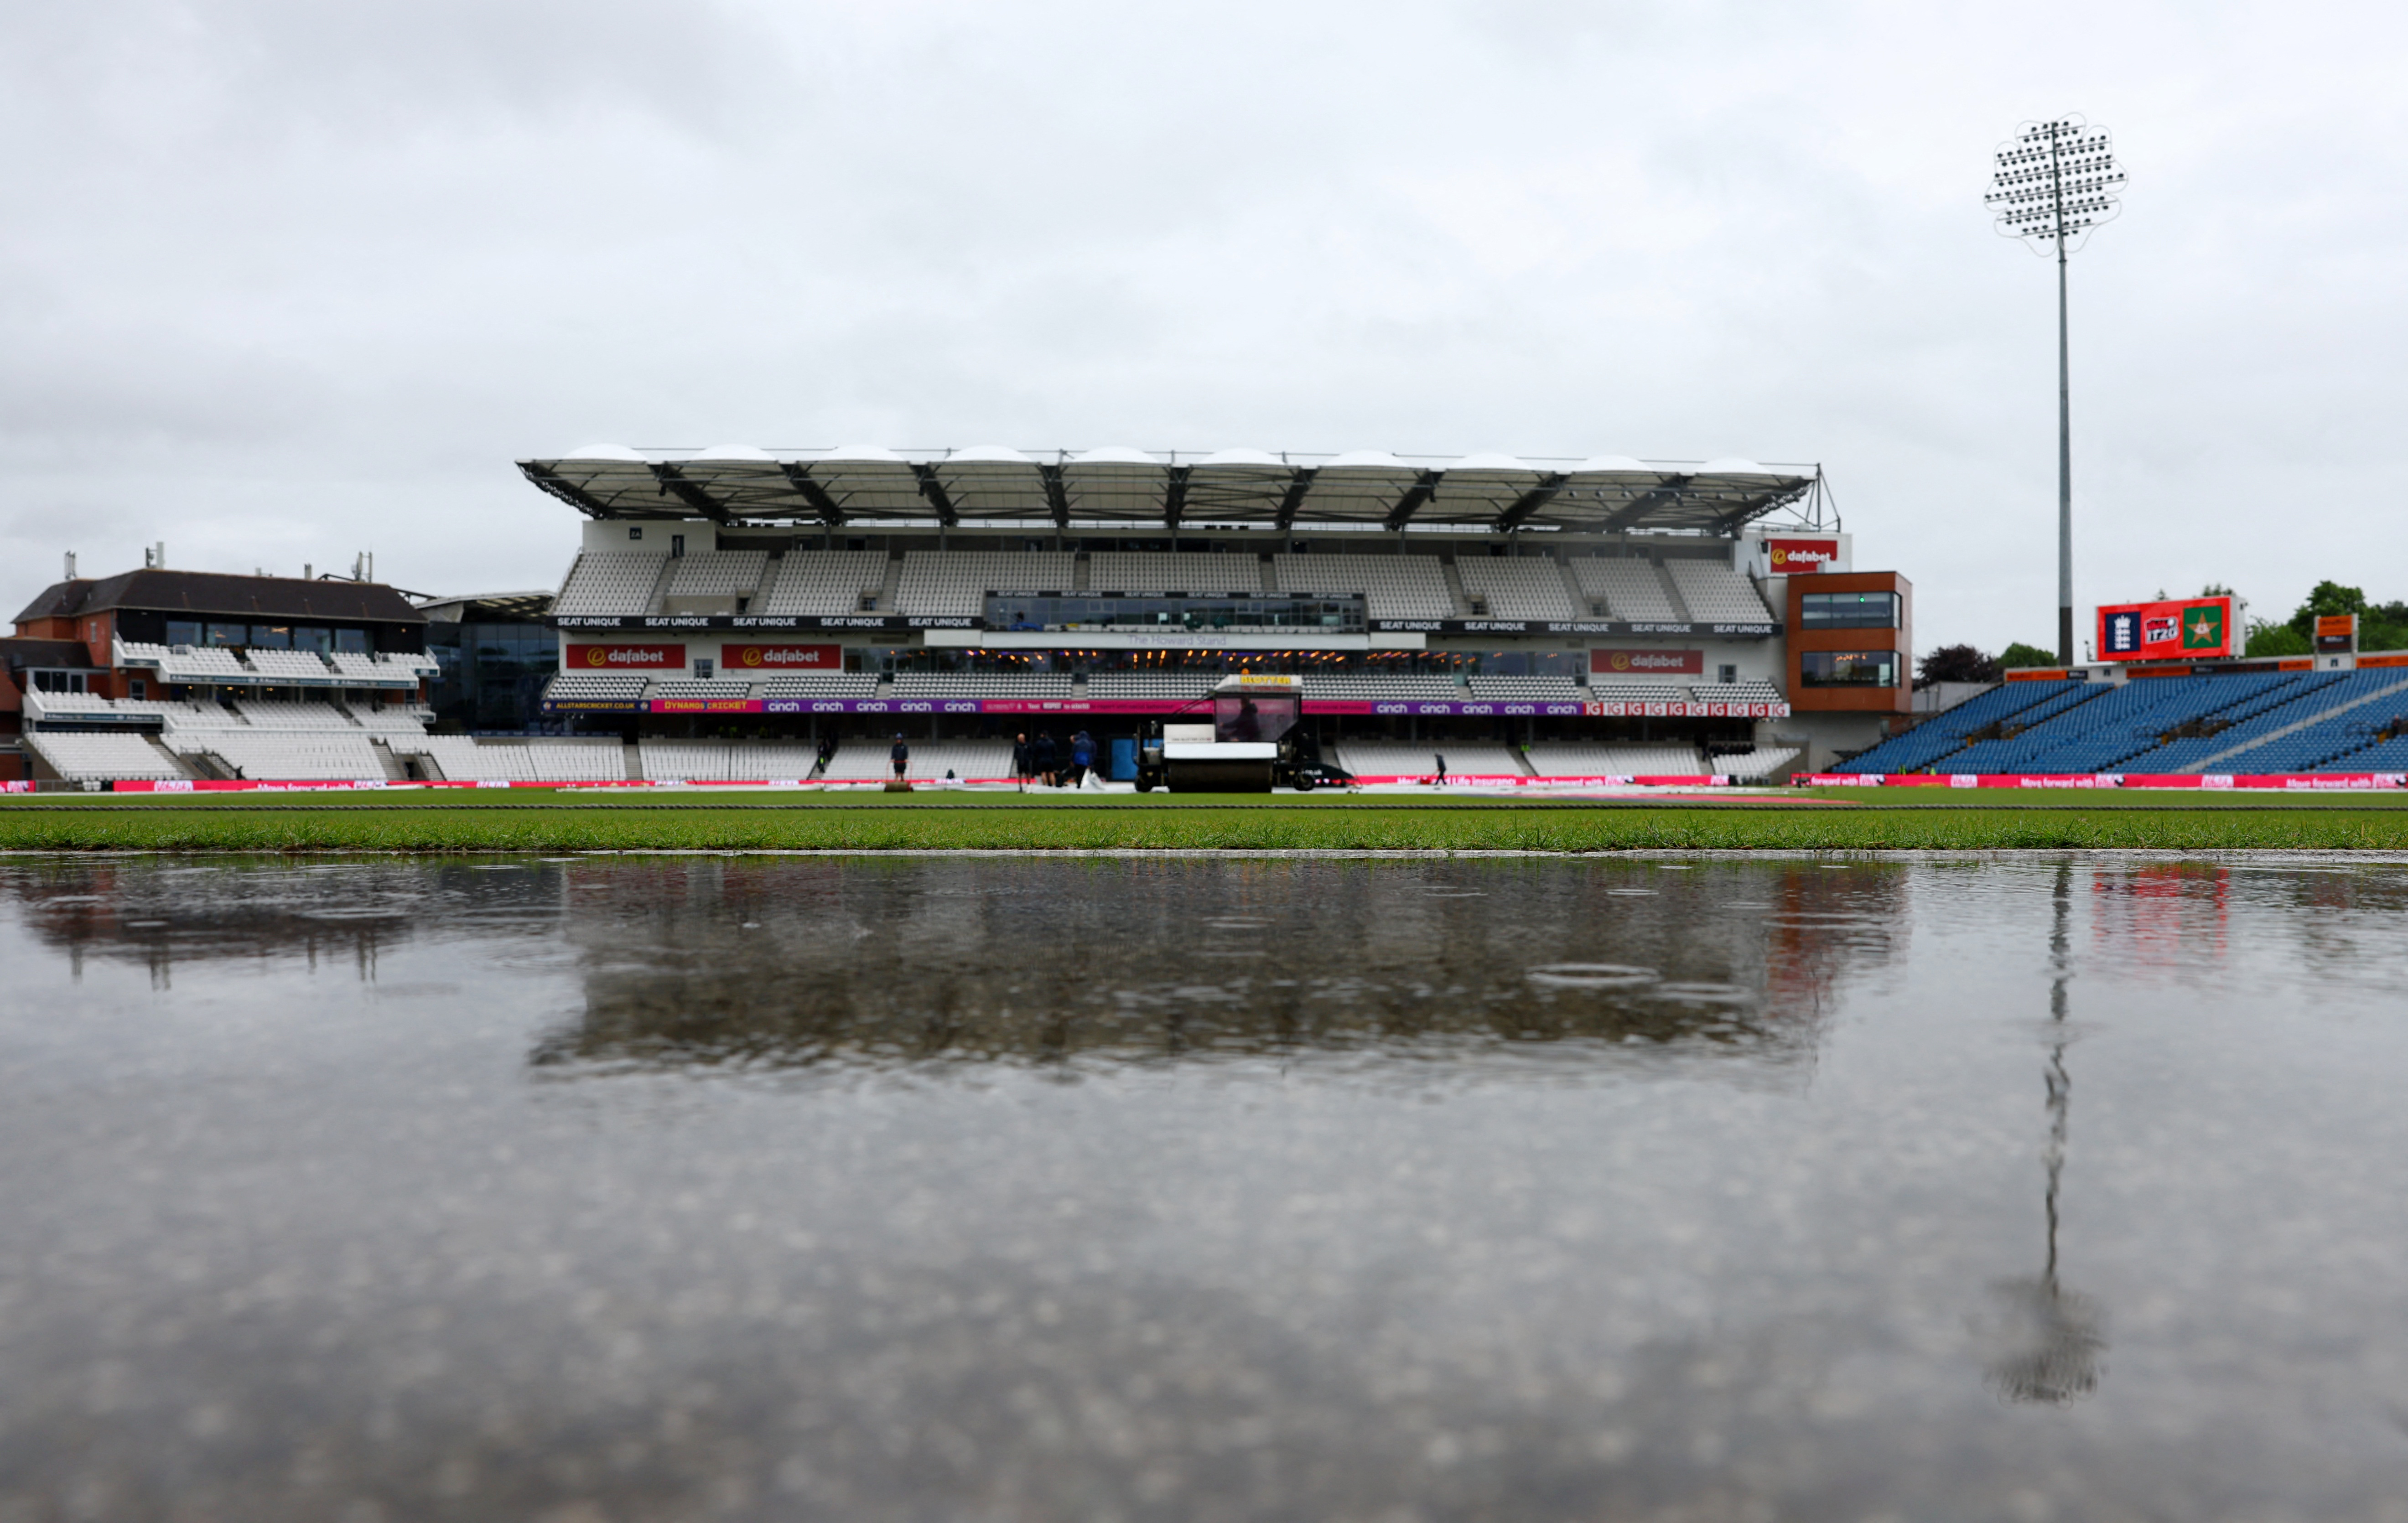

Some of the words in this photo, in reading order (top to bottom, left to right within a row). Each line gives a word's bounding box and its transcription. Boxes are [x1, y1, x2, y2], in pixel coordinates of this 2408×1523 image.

[1787, 550, 1831, 563] dafabet
[558, 617, 581, 626] SEAT
[584, 618, 620, 626] UNIQUE
[671, 618, 708, 626] UNIQUE
[759, 618, 796, 626] UNIQUE
[847, 618, 883, 627] UNIQUE
[934, 618, 971, 627] UNIQUE
[1380, 621, 1403, 629] SEAT
[1405, 622, 1441, 630] UNIQUE
[1573, 623, 1608, 632] UNIQUE
[1656, 624, 1690, 632] UNIQUE
[1738, 625, 1771, 633] UNIQUE
[2147, 626, 2178, 642] IT20
[1127, 634, 1148, 645] The
[1151, 634, 1194, 645] Howard
[1197, 634, 1227, 646] Stand
[608, 650, 663, 663] dafabet
[764, 649, 819, 663] dafabet
[1631, 655, 1683, 668] dafabet
[664, 701, 705, 709] DYNAMOS
[706, 701, 747, 709] CRICKET
[768, 702, 799, 711] cinch
[813, 701, 843, 711] cinch
[856, 702, 887, 711] cinch
[901, 702, 931, 711] cinch
[945, 702, 976, 711] cinch
[1377, 704, 1407, 713] cinch
[1420, 704, 1450, 714] cinch
[1463, 705, 1492, 714] cinch
[1505, 705, 1535, 714] cinch
[1547, 705, 1577, 714] cinch
[1586, 703, 1600, 715] IG
[1608, 703, 1621, 715] IG
[1628, 703, 1642, 715] IG
[1649, 703, 1662, 715] IG
[1670, 703, 1684, 715] IG
[1691, 703, 1704, 716] IG
[1711, 703, 1725, 716] IG
[1732, 704, 1744, 716] IG
[1752, 704, 1766, 716] IG
[1772, 704, 1785, 716] IG
[1452, 776, 1470, 785] Life
[1811, 776, 1840, 786] forward
[1841, 776, 1858, 786] with
[2021, 778, 2042, 788] Move
[2043, 777, 2074, 788] forward
[2076, 777, 2094, 788] with
[2286, 778, 2311, 788] Move
[2312, 777, 2348, 788] forward
[2350, 777, 2371, 788] with
